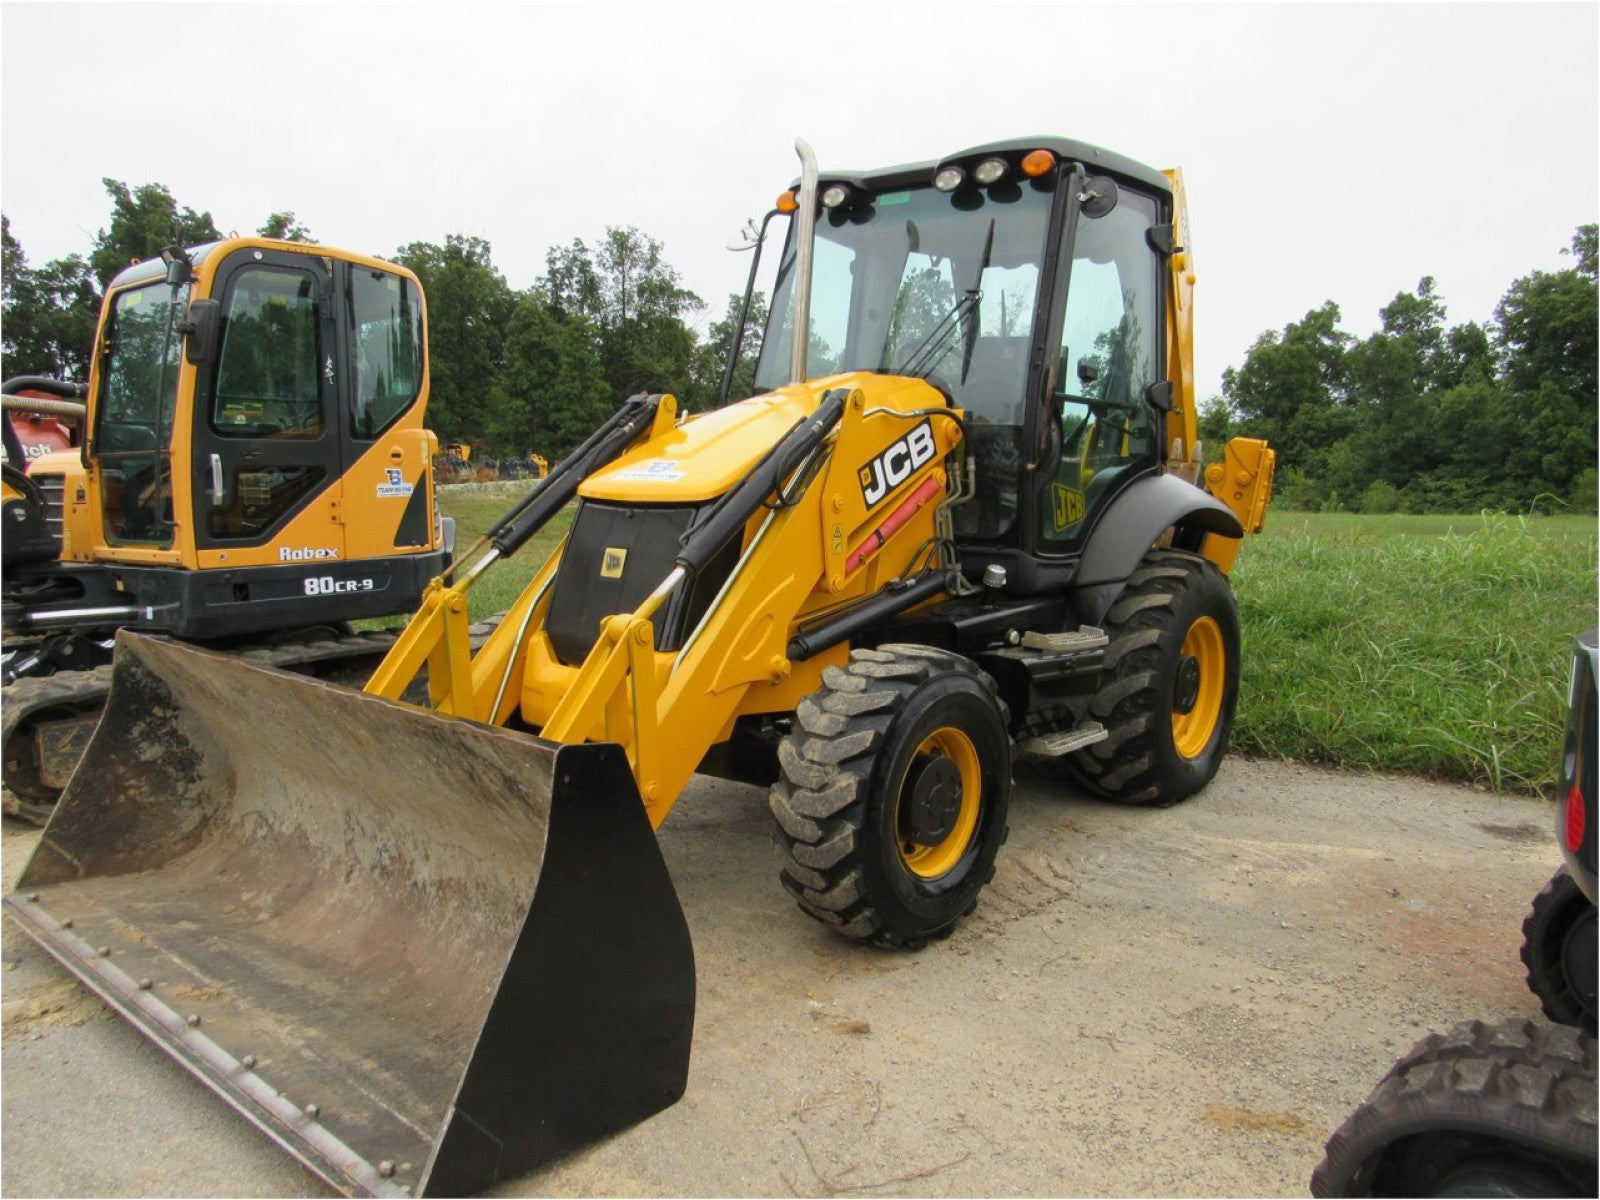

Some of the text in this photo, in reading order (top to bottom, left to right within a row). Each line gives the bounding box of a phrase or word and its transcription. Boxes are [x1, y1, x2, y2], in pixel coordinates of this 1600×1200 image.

[864, 423, 935, 505] JCB
[1056, 488, 1083, 527] JCB
[279, 547, 338, 561] Robex
